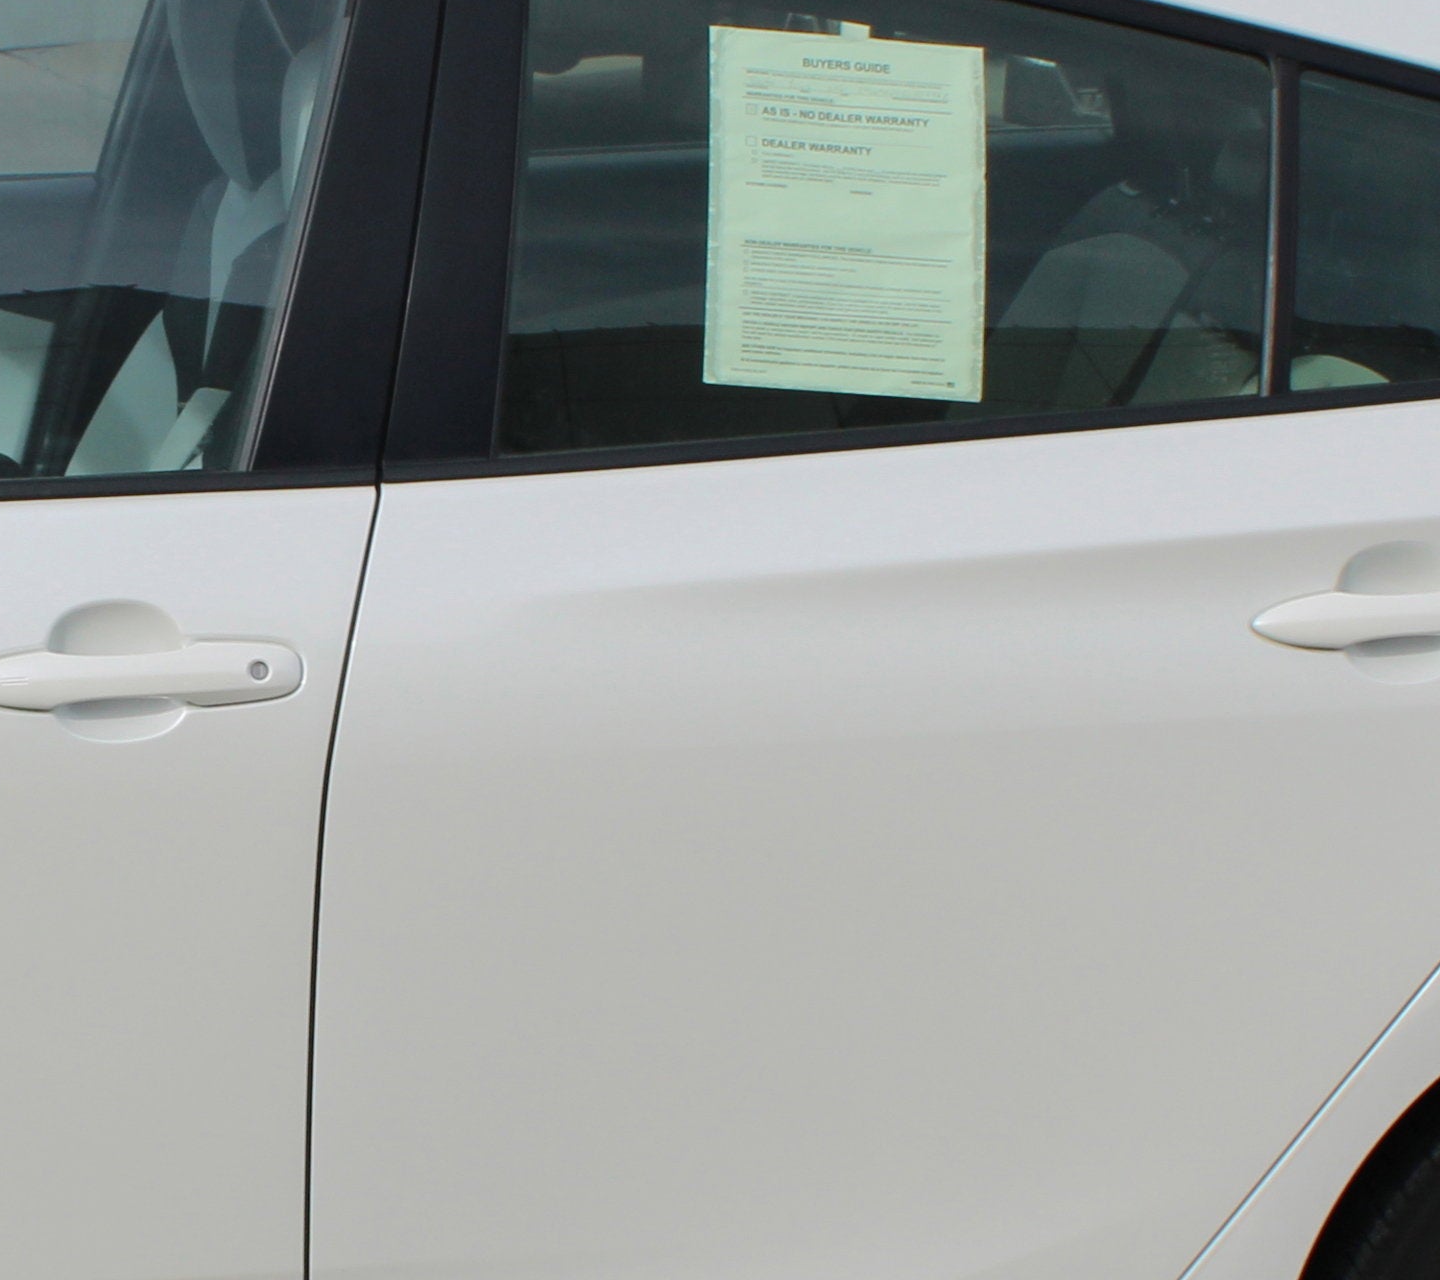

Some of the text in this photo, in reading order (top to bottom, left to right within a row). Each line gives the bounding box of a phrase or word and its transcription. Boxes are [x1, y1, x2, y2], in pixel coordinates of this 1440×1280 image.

[801, 57, 891, 75] BUYERS GUIDE
[761, 106, 777, 117] AS
[779, 107, 792, 118] IS
[799, 108, 816, 120] NO
[818, 111, 863, 124] DEALER
[865, 114, 930, 129] WARRANTY
[761, 137, 872, 156] DEALER WARRANTY
